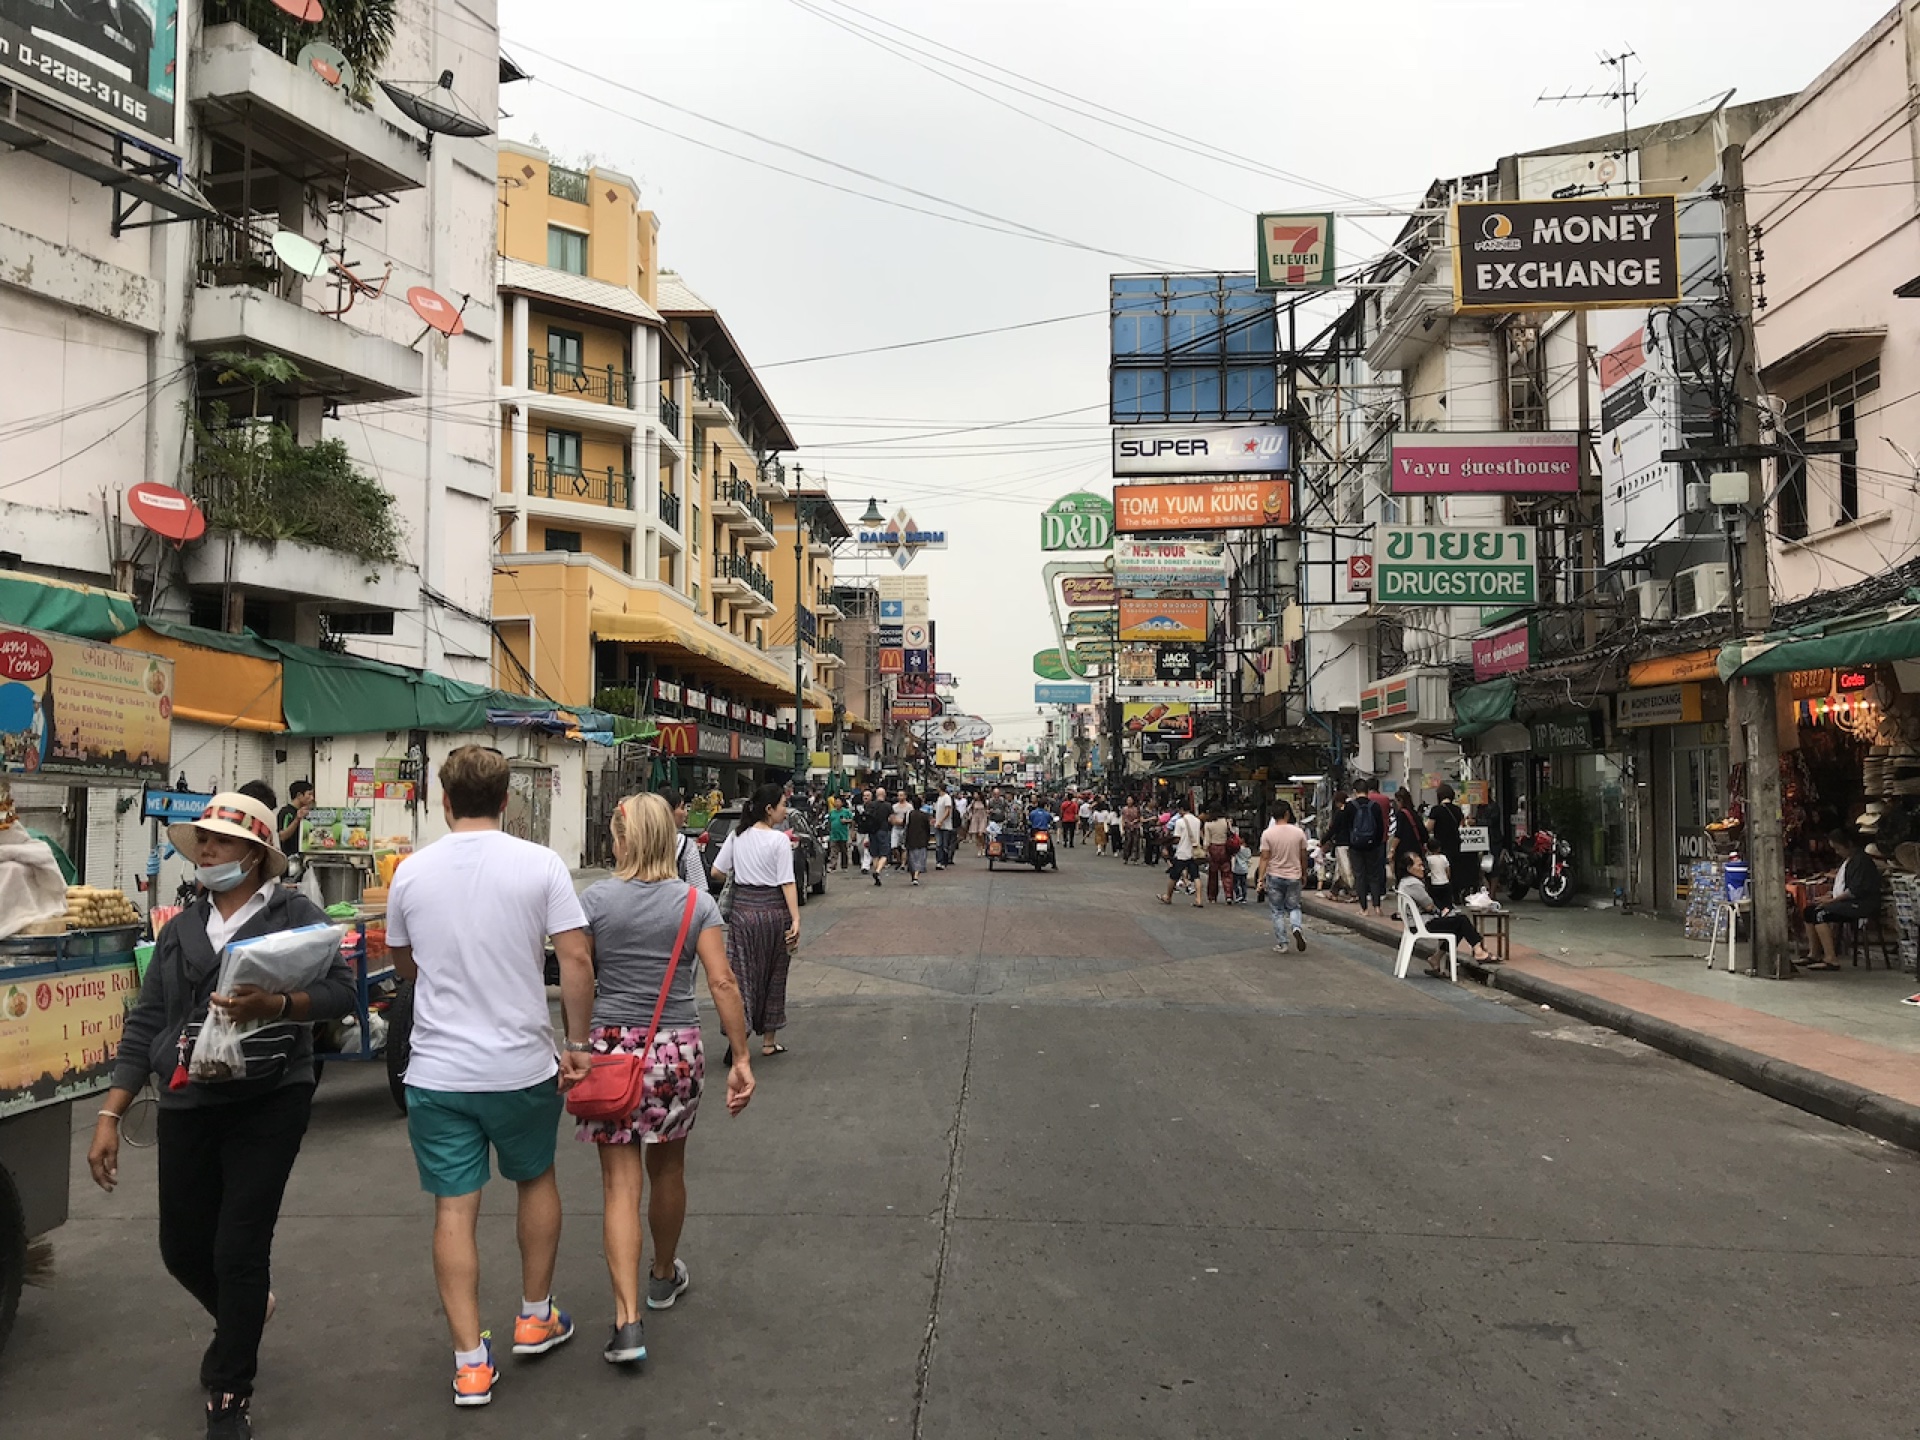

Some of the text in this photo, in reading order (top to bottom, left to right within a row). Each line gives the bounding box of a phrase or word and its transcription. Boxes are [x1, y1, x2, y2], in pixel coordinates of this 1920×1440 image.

[18, 43, 147, 122] 0-2282-3166
[1533, 214, 1658, 243] MONEY
[1477, 258, 1661, 290] EXCHANGE
[1120, 439, 1209, 456] SUPER
[1401, 456, 1571, 478] Vayu guesthouse
[1120, 498, 1159, 515] TOM
[1164, 496, 1204, 514] YUM
[1211, 493, 1259, 512] KUNG
[1044, 514, 1108, 549] D&D
[1125, 518, 1139, 526] The
[1161, 516, 1179, 525] Thai
[1181, 516, 1211, 524] Cuisine
[1132, 546, 1186, 557] N.S. TOUR
[1386, 531, 1527, 561] ขายยา
[1386, 571, 1526, 595] DRUGSTORE
[0, 641, 27, 659] ung
[1162, 654, 1190, 663] JACK
[8, 655, 39, 677] Yong
[56, 977, 105, 1007] Spring
[81, 1019, 102, 1037] For
[108, 1013, 121, 1031] 10
[64, 1052, 70, 1069] 3
[82, 1047, 103, 1065] For
